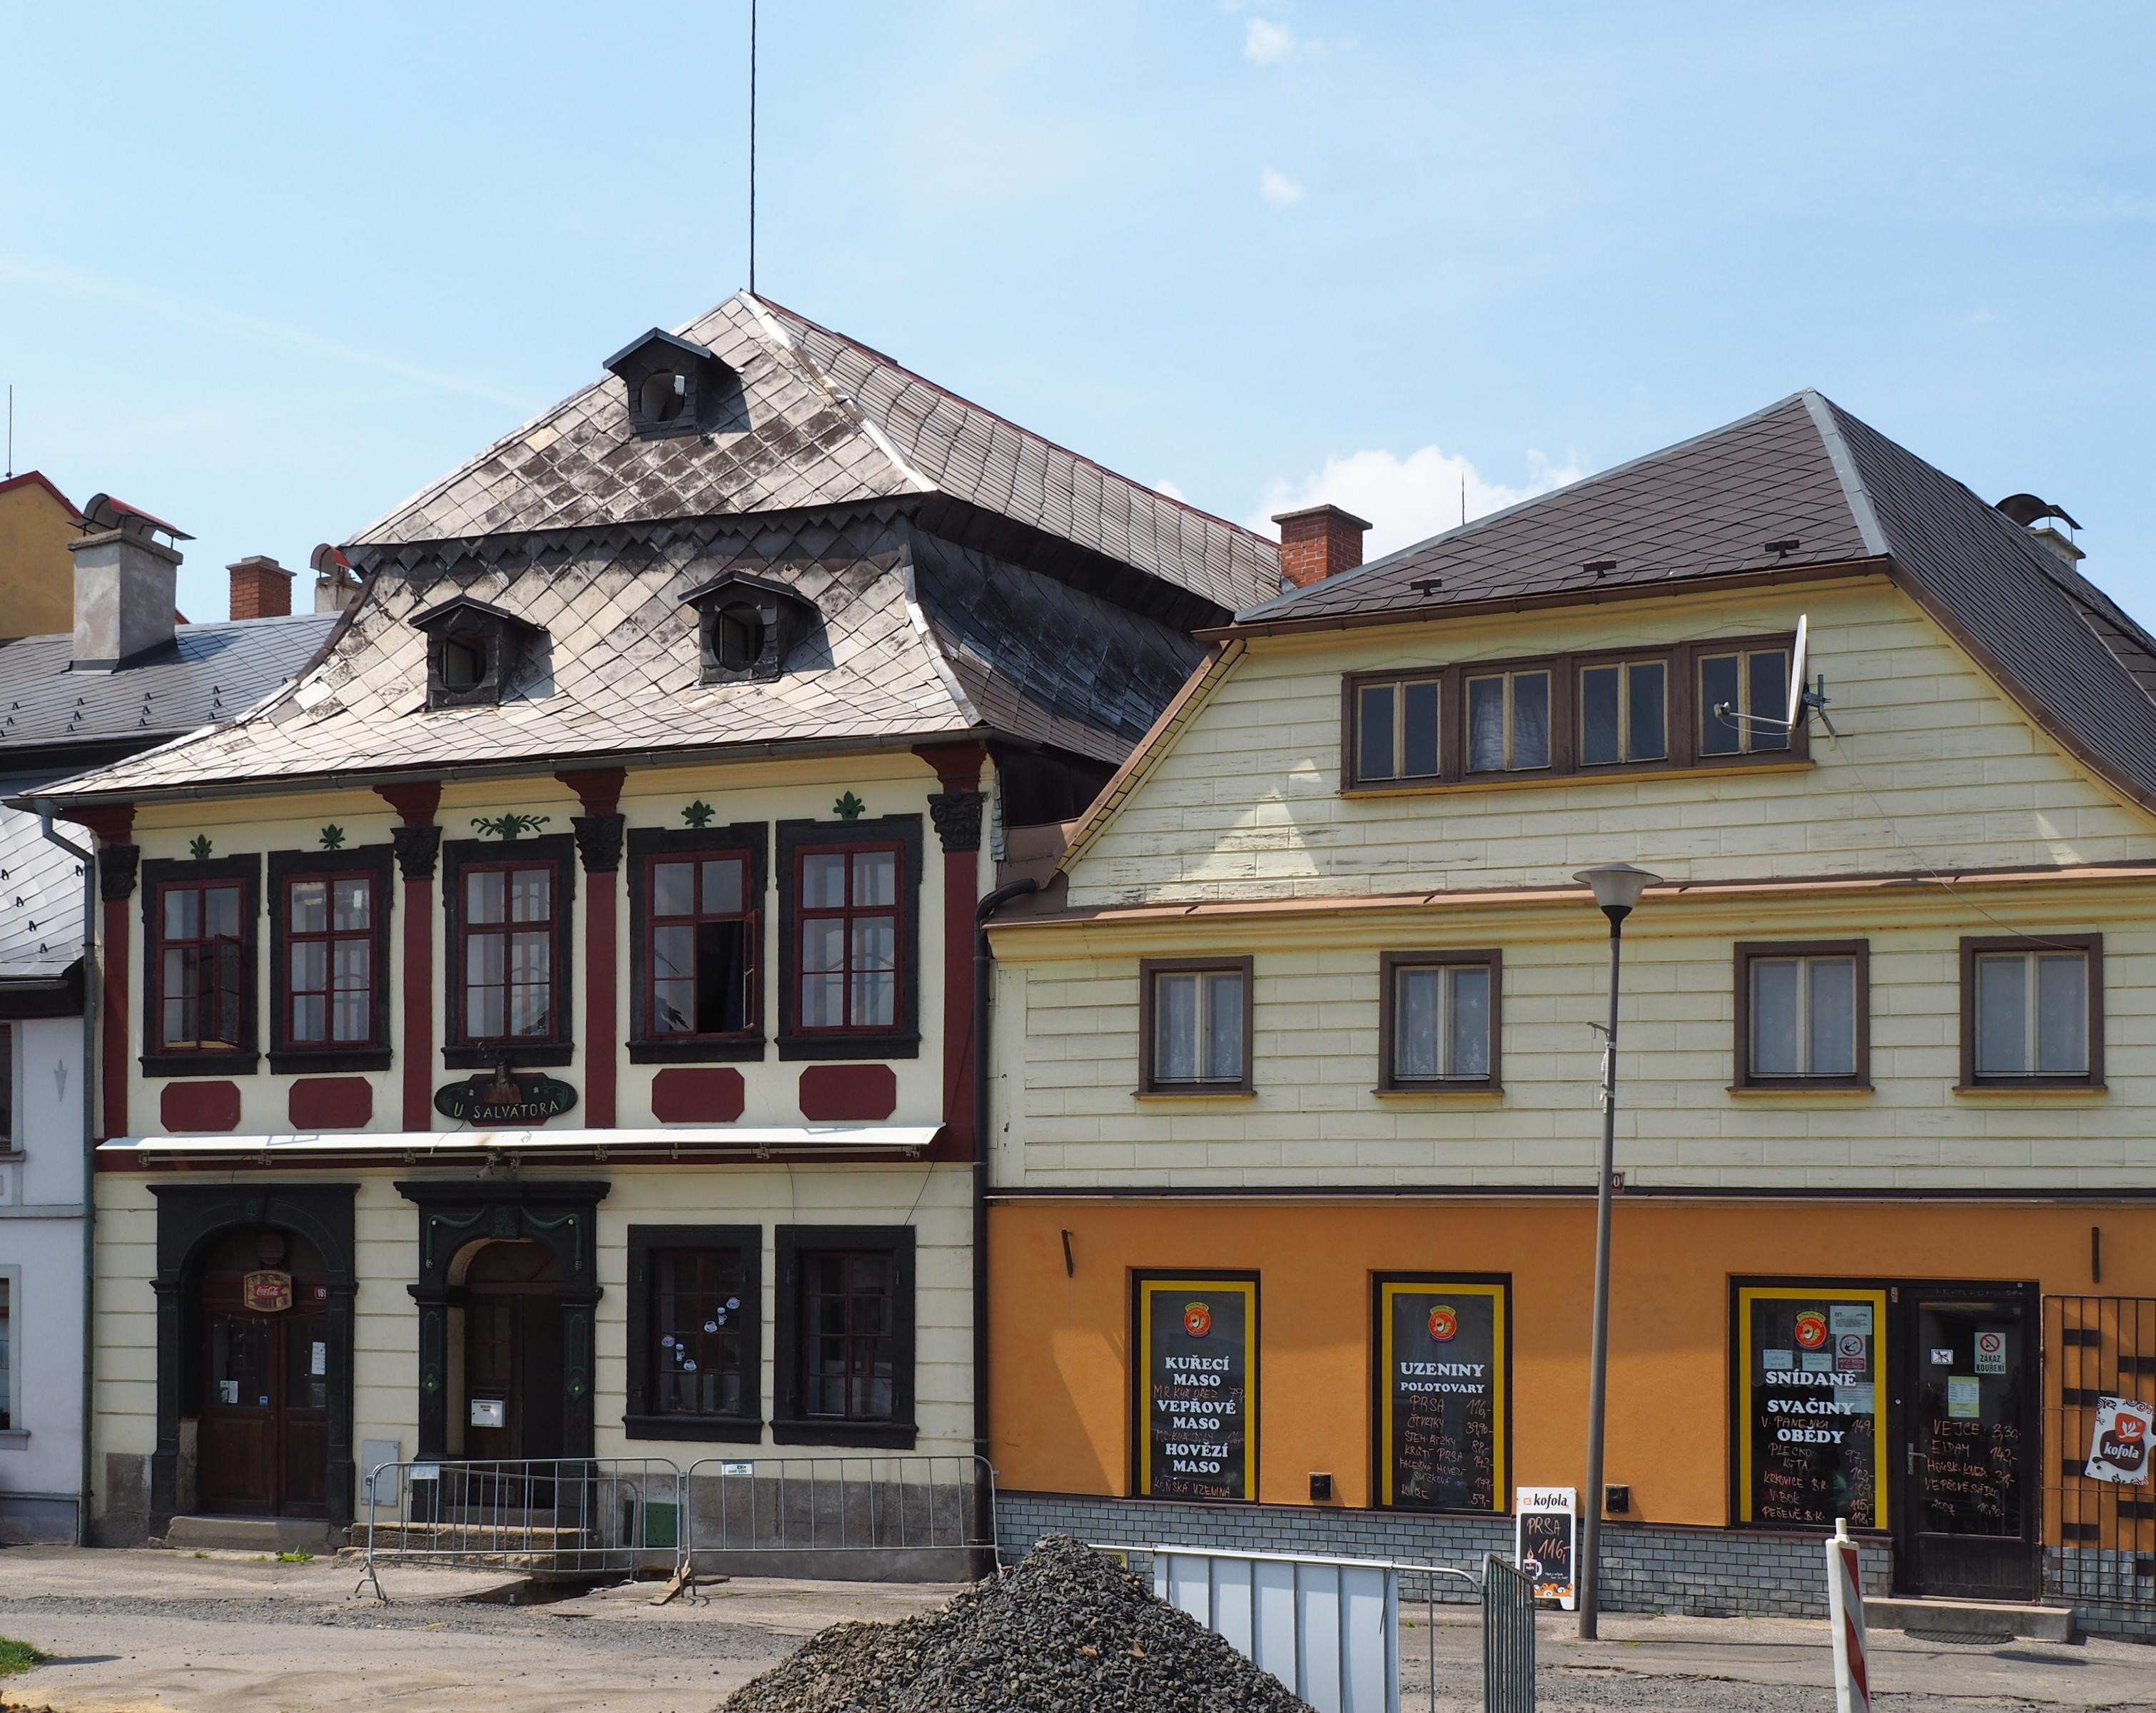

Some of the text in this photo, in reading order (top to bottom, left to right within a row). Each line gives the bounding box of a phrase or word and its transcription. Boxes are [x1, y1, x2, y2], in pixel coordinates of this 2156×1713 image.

[454, 1100, 560, 1118] U SALVÁTORA
[1165, 1354, 1230, 1370] KUŘECÍ
[1980, 1354, 2001, 1363] ZÁKAZ
[1400, 1362, 1485, 1377] UZENINY
[1976, 1363, 2005, 1372] KOUŘENÍ
[1173, 1373, 1221, 1386] MASO
[1766, 1368, 1856, 1386] SNÍDANĚ
[1400, 1382, 1485, 1394] POLOTOVARY
[1157, 1398, 1237, 1415] VEPŘOVÉ
[1410, 1395, 1444, 1413] PRSA
[1767, 1397, 1855, 1415] SVAČINY
[1173, 1416, 1220, 1430] MASO
[1773, 1415, 1829, 1430] PANENKA
[1933, 1418, 1980, 1437] VEJCE
[1777, 1426, 1846, 1444] OBĚDY
[1165, 1441, 1229, 1457] HOVĚZÍ
[2103, 1441, 2140, 1460] kofola
[1173, 1460, 1220, 1473] MASO
[1533, 1492, 1567, 1510] kofola
[1526, 1516, 1562, 1536] PRSA
